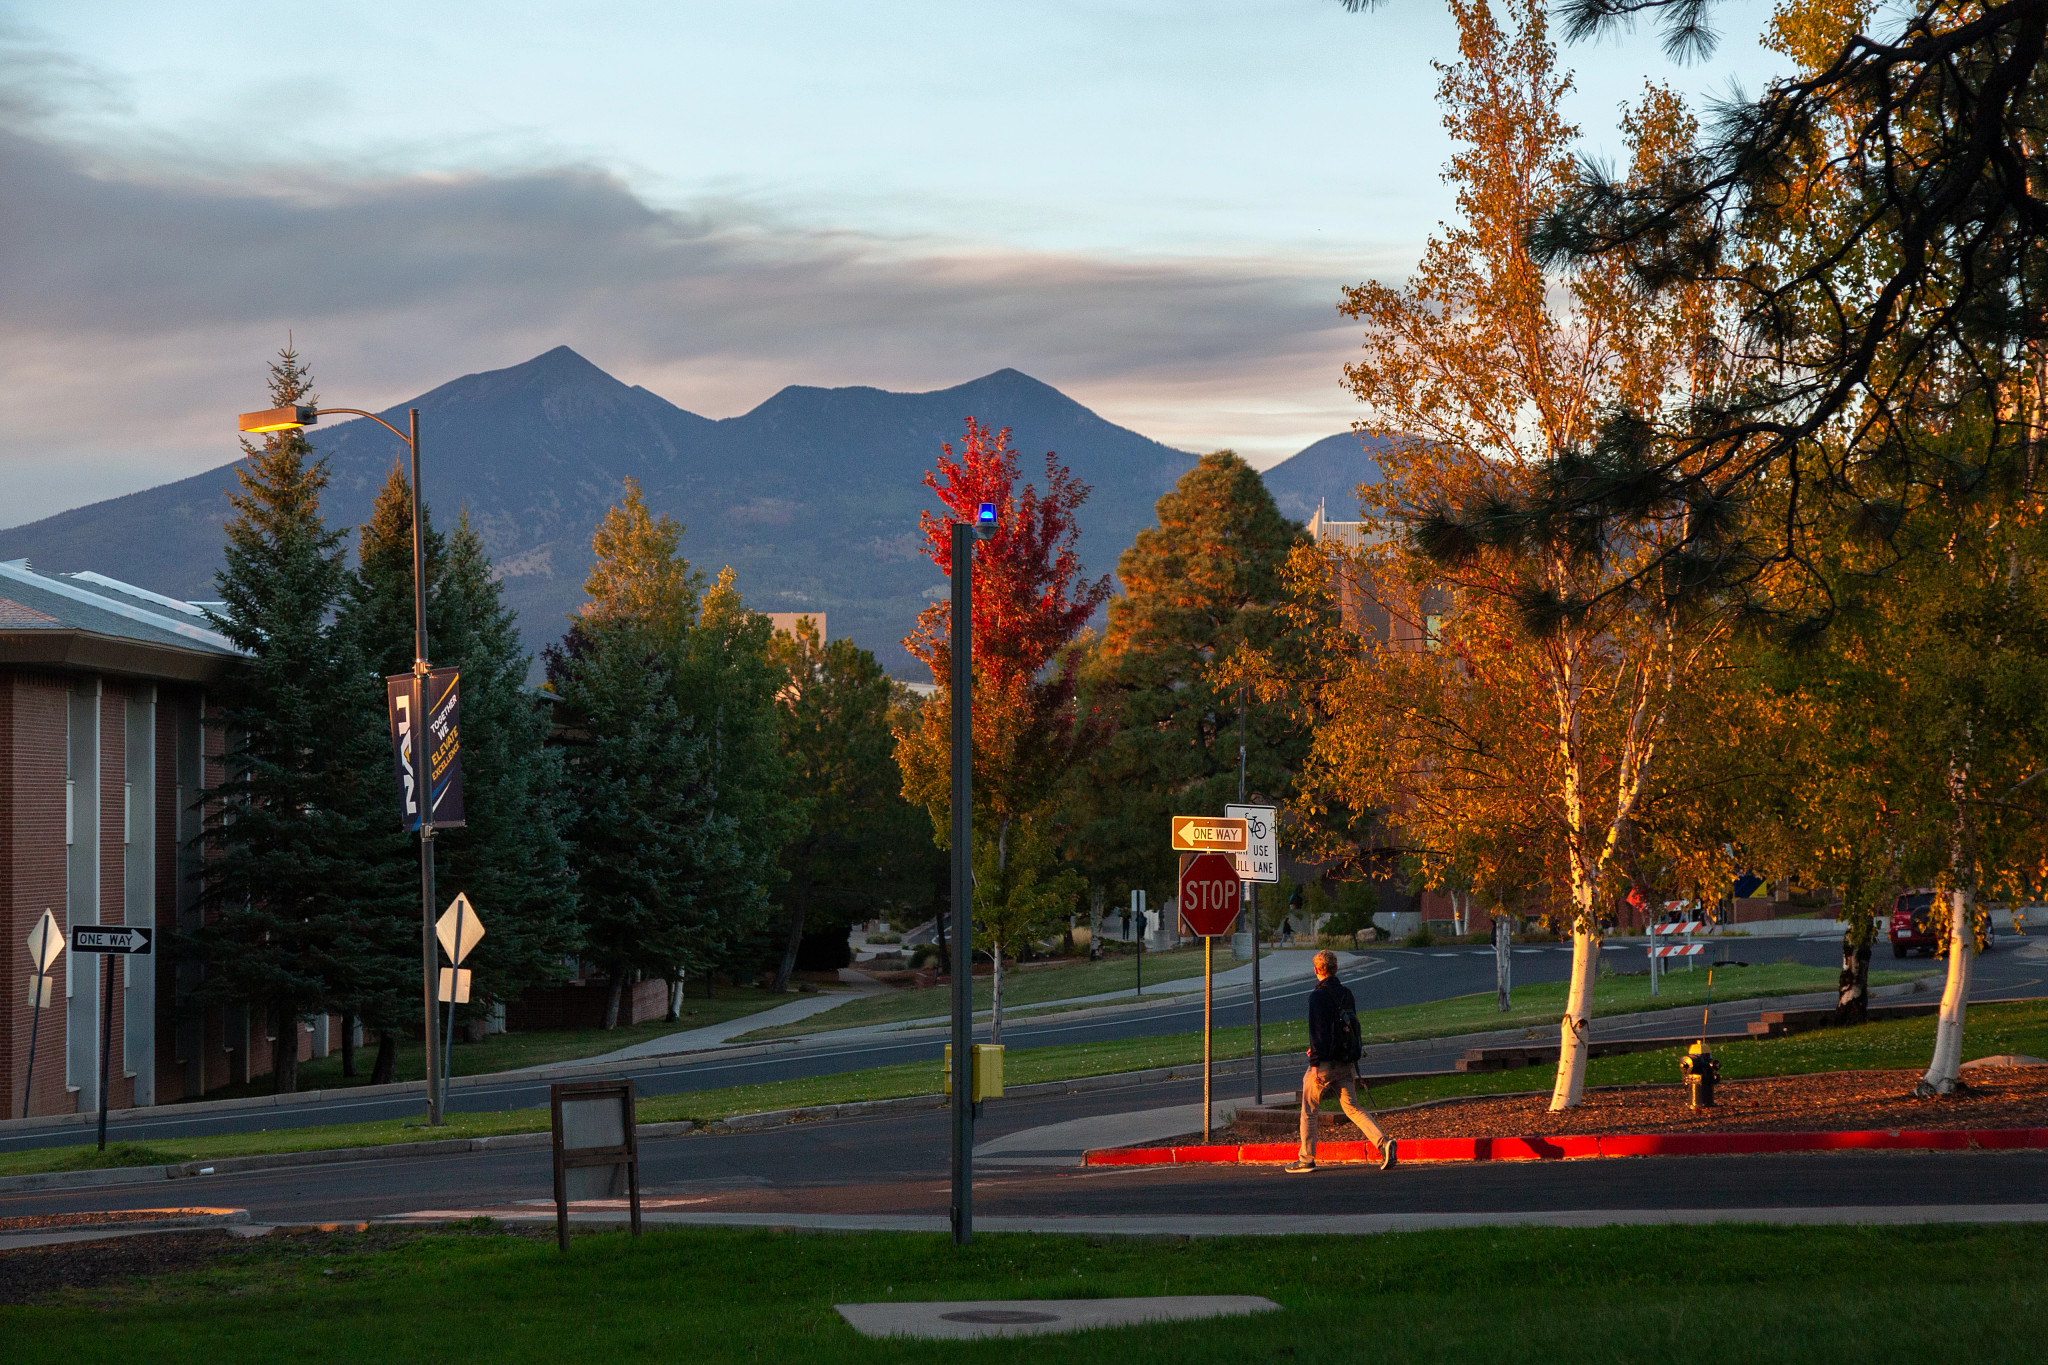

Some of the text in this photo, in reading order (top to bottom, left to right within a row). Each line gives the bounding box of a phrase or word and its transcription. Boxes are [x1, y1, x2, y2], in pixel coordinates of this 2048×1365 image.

[430, 694, 458, 734] TOGETHER
[437, 722, 450, 741] WE
[396, 695, 417, 816] NAU
[431, 725, 459, 766] ELEVATE
[431, 741, 460, 781] EXCELLENCE
[1194, 828, 1239, 840] ONE WAY
[1253, 845, 1269, 856] USE
[1235, 861, 1273, 873] ULL LANE
[1185, 880, 1237, 910] STOP
[80, 933, 133, 946] ONE WAY
